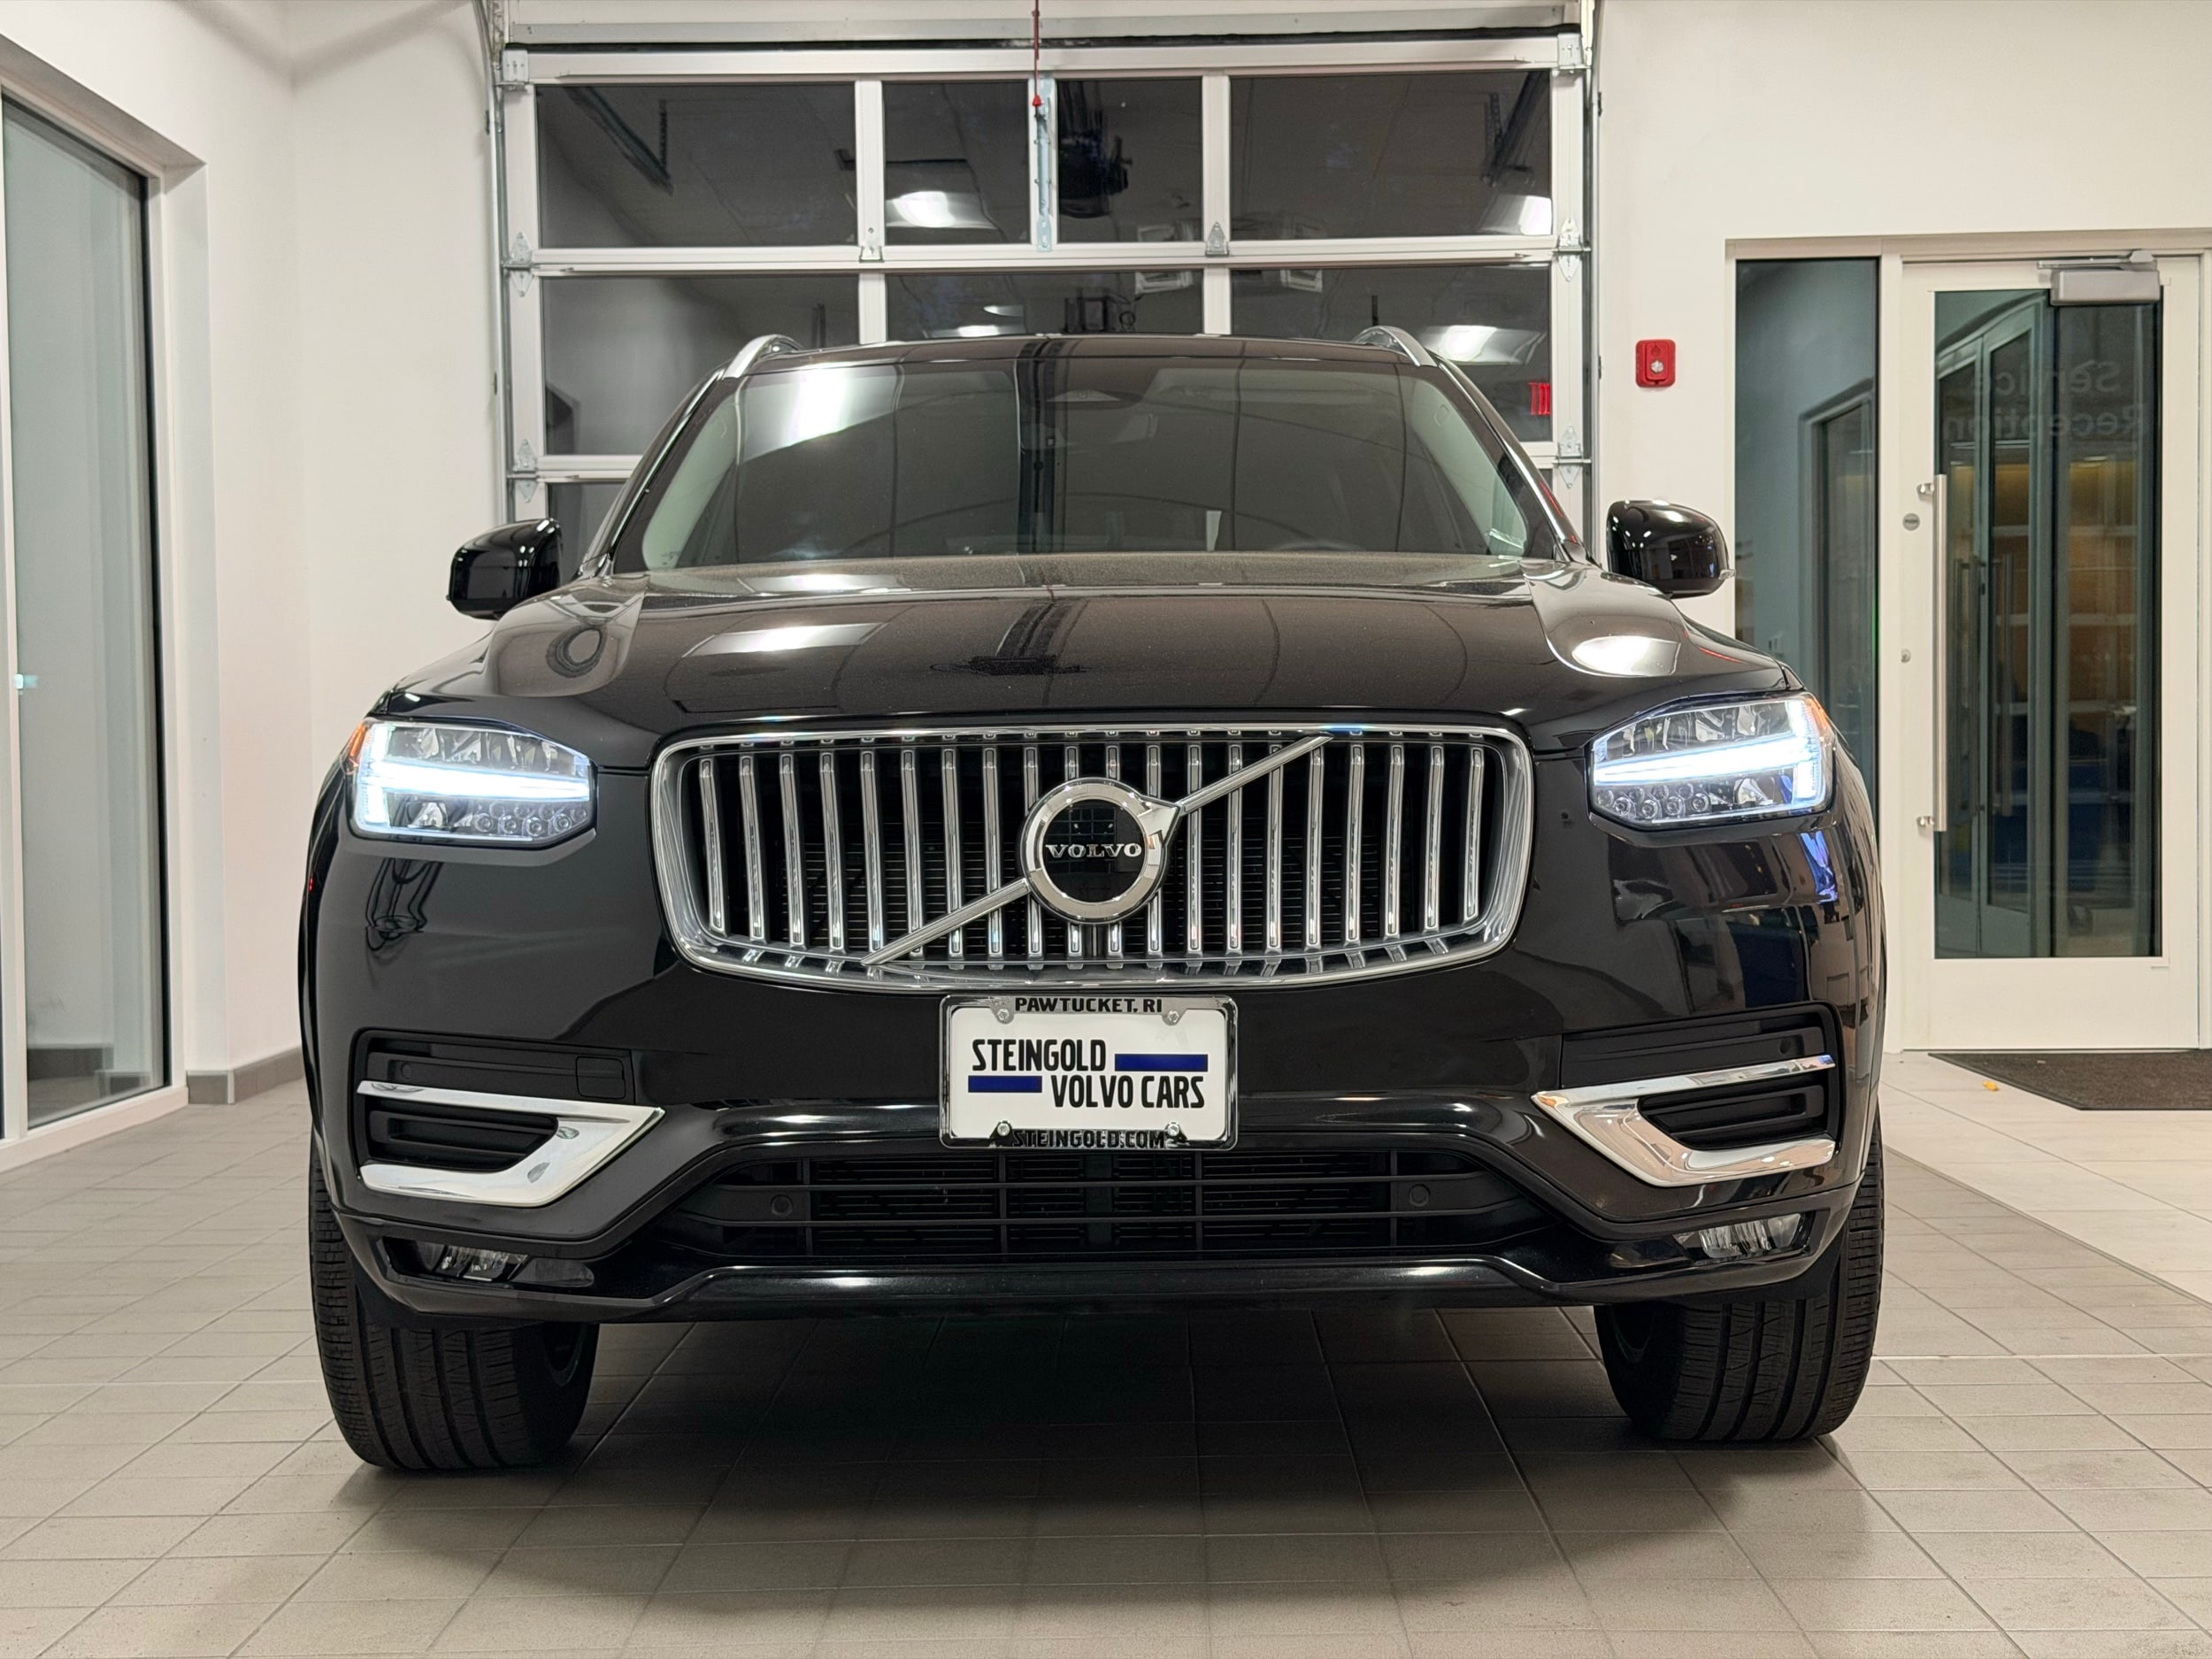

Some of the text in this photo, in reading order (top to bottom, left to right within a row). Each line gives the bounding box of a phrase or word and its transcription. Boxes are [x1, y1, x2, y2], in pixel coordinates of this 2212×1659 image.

[1045, 842, 1142, 858] VOLVO
[1142, 998, 1163, 1013] RI
[972, 1039, 1106, 1071] STEINGOLD
[1050, 1074, 1205, 1109] VOLVO CARS
[1012, 1130, 1165, 1148] STEINGOLD.COM
